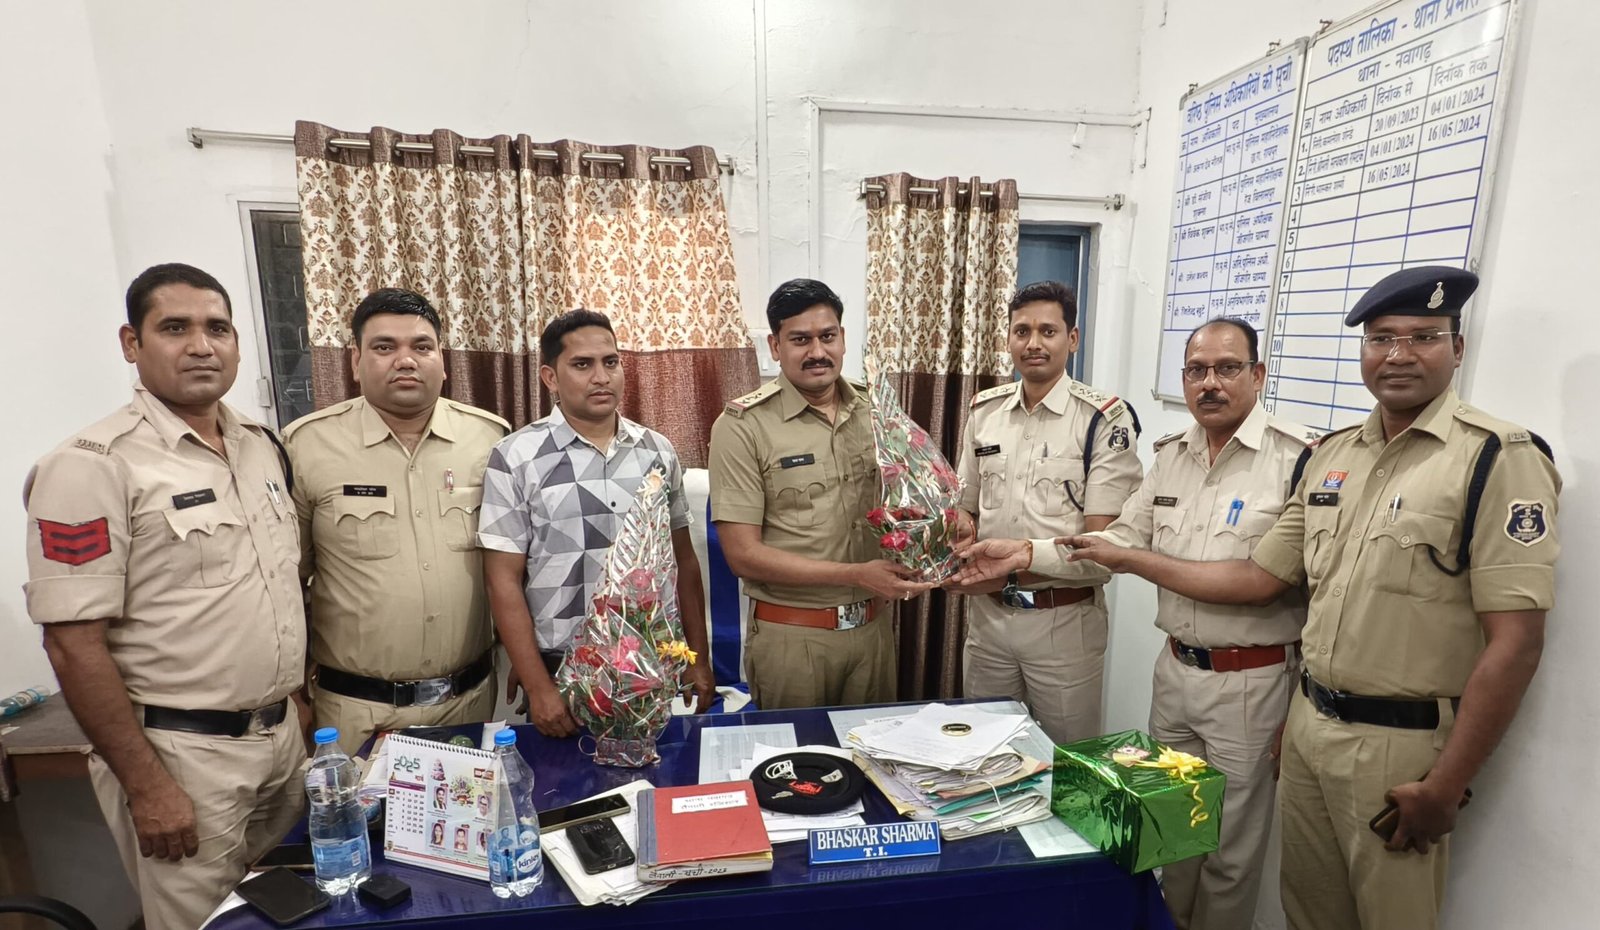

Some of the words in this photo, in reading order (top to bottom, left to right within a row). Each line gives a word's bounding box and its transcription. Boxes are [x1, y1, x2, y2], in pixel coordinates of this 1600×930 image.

[1327, 35, 1356, 68] पदस्थ
[1356, 17, 1398, 53] तालिका
[1413, 0, 1441, 30] थाना
[1357, 61, 1382, 83] थाना
[1394, 40, 1434, 68] नवागढ़
[1262, 64, 1274, 90] की
[1434, 62, 1465, 87] दिनांक
[1335, 94, 1368, 119] अधिकारी
[1376, 83, 1403, 107] दिनांक
[1288, 232, 1295, 246] 5
[1283, 275, 1289, 288] 7
[1273, 339, 1281, 352] 10
[394, 755, 420, 773] 2025
[816, 827, 879, 850] BHASKAR
[881, 822, 936, 845] SHARMA
